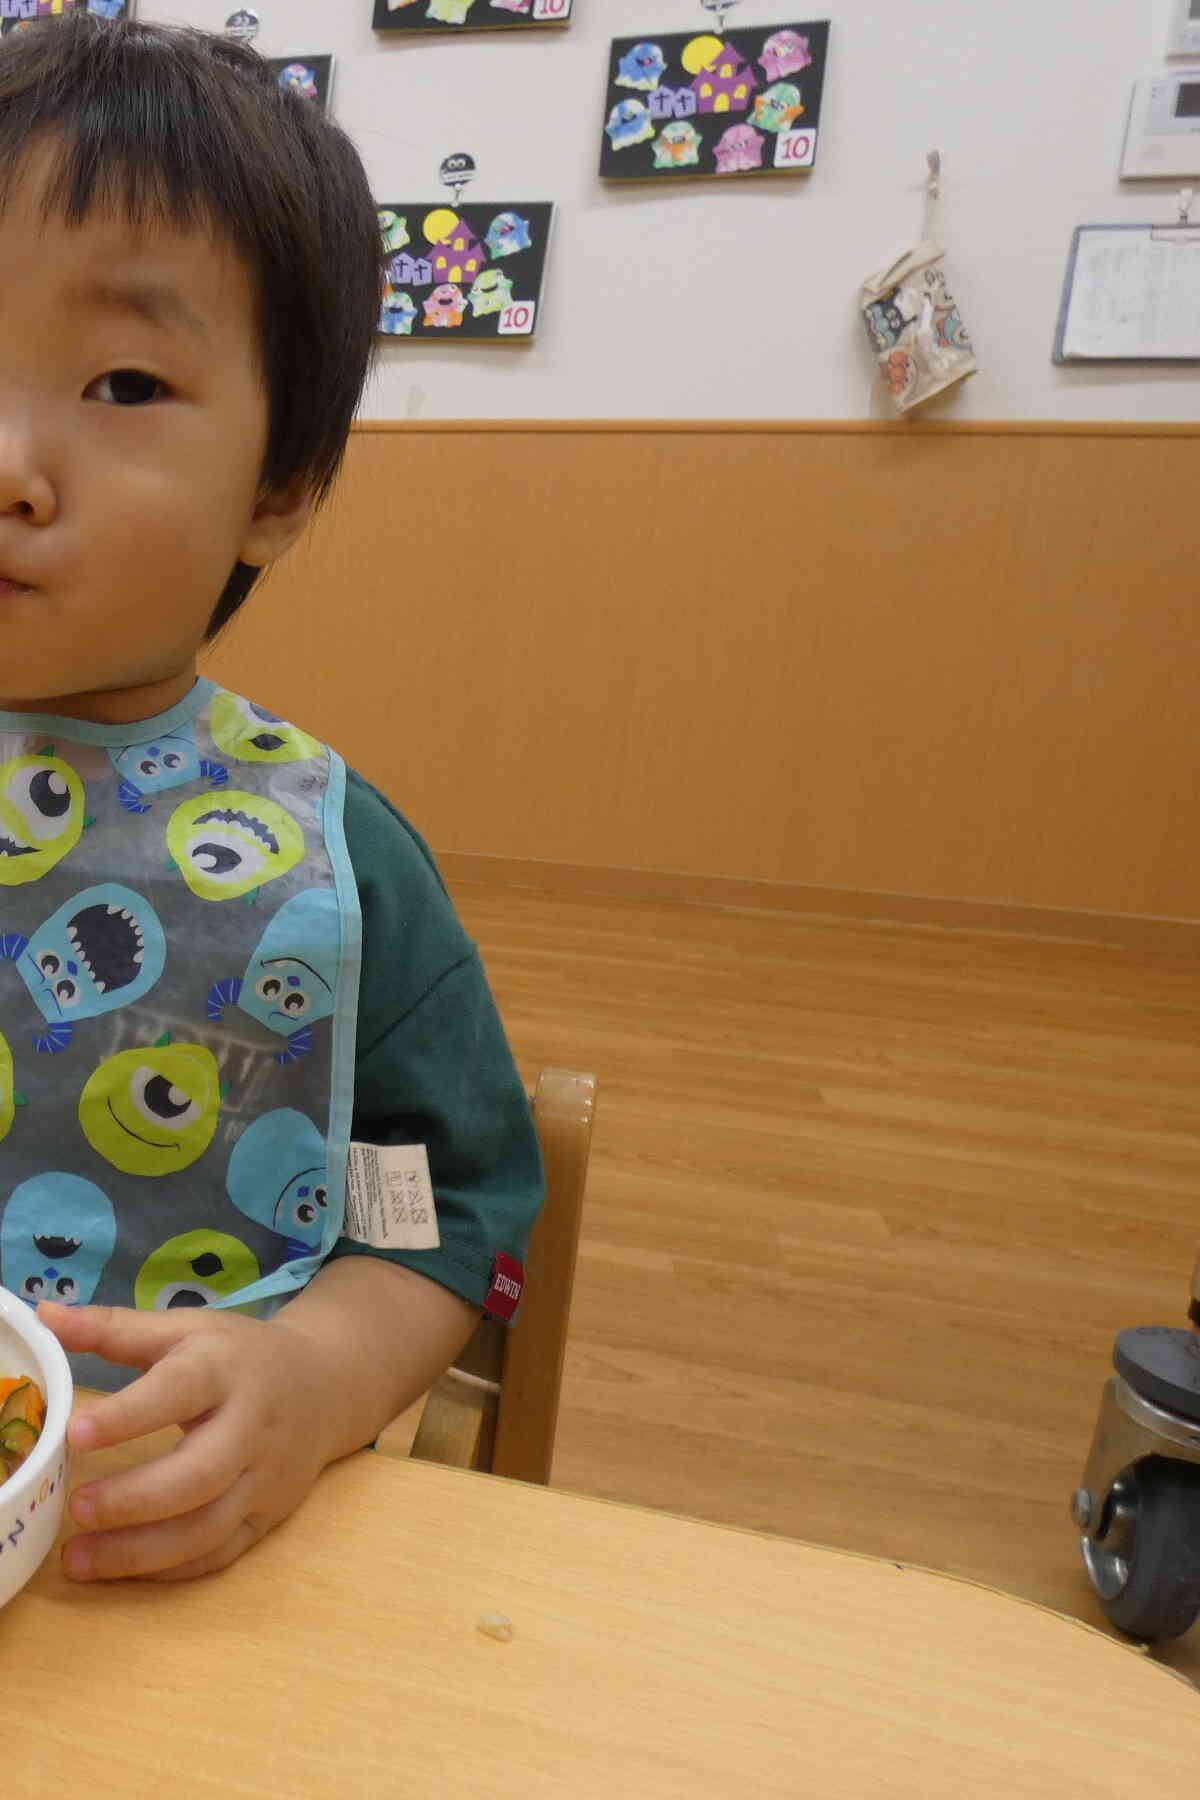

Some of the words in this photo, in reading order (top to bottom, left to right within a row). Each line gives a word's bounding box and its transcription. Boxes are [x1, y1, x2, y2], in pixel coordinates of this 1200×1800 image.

[783, 136, 810, 159] 10
[503, 307, 529, 328] 10
[494, 1272, 521, 1300] EDWIN
